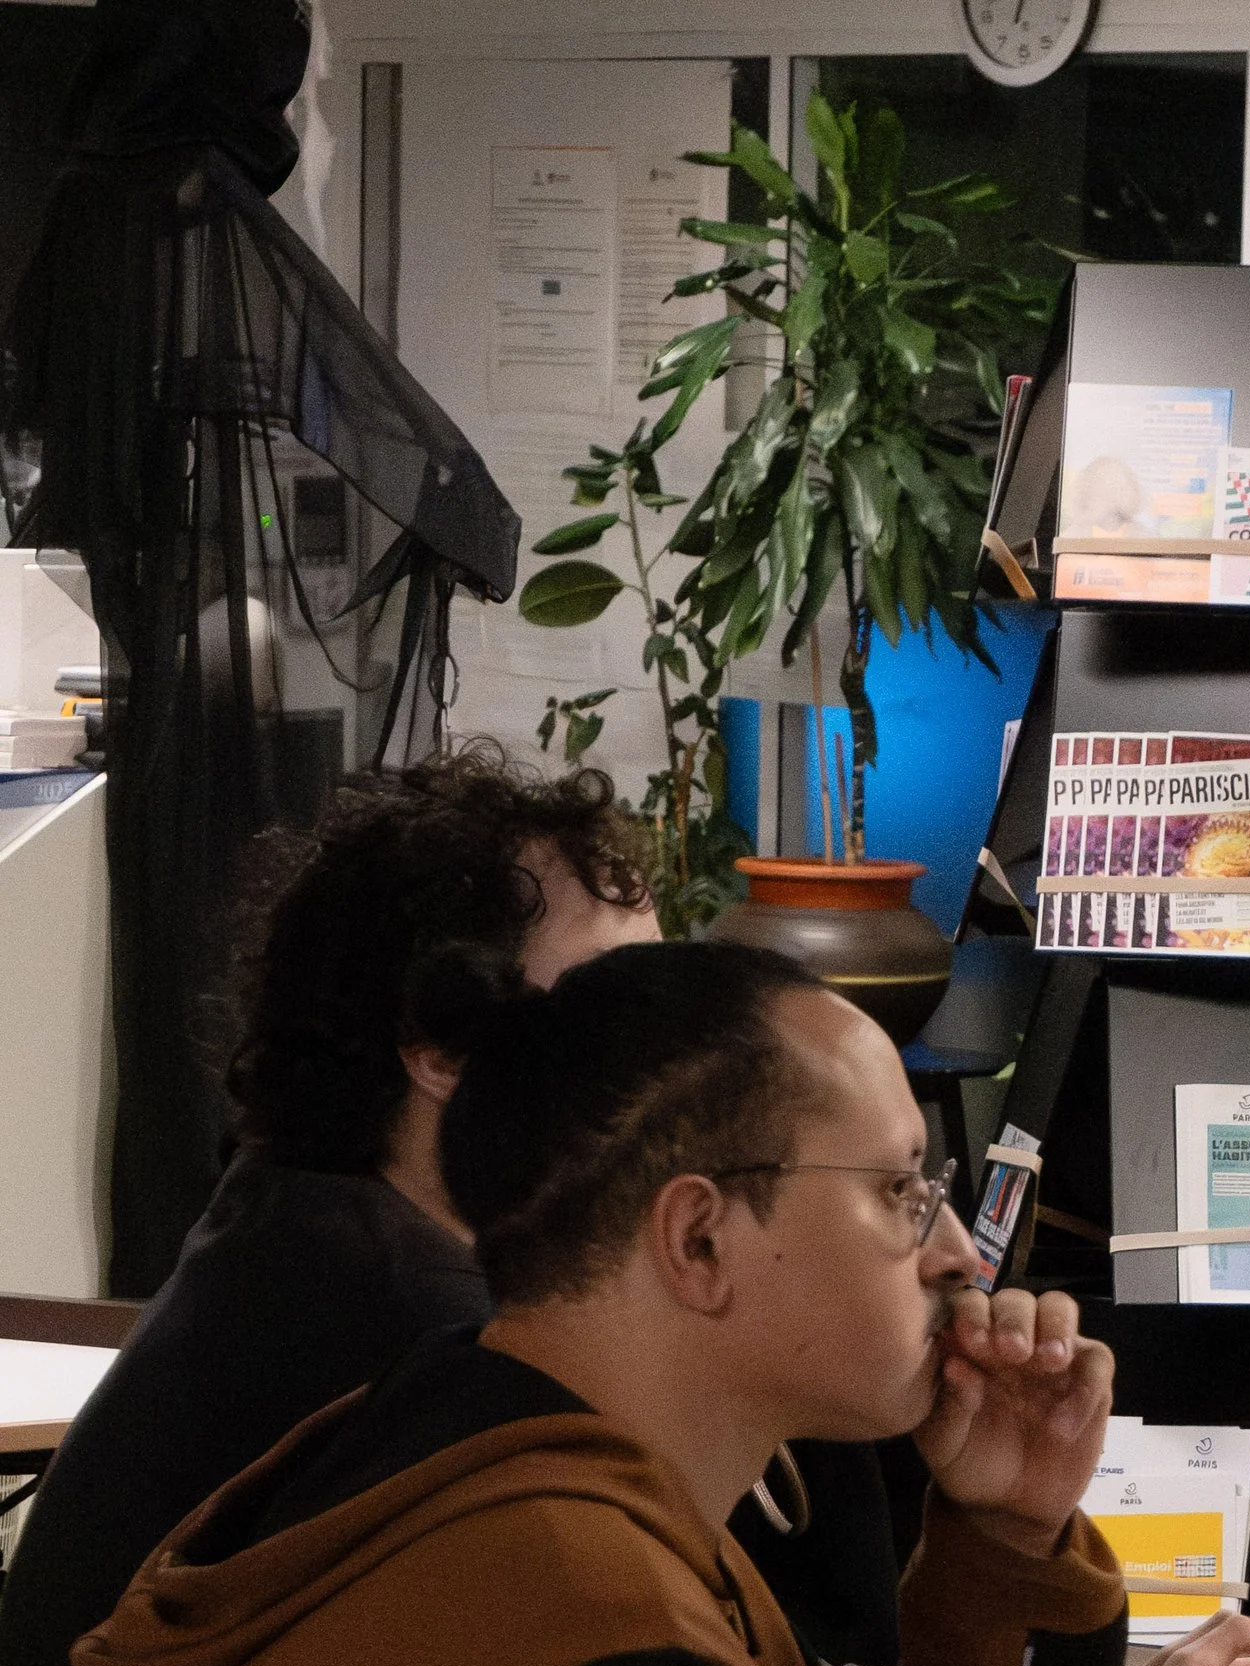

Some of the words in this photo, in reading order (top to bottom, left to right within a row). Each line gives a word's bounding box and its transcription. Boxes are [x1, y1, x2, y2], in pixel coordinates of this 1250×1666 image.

[1187, 1459, 1218, 1469] PARIS
[1100, 1467, 1125, 1475] PARIS
[1125, 1561, 1171, 1573] Emploi
